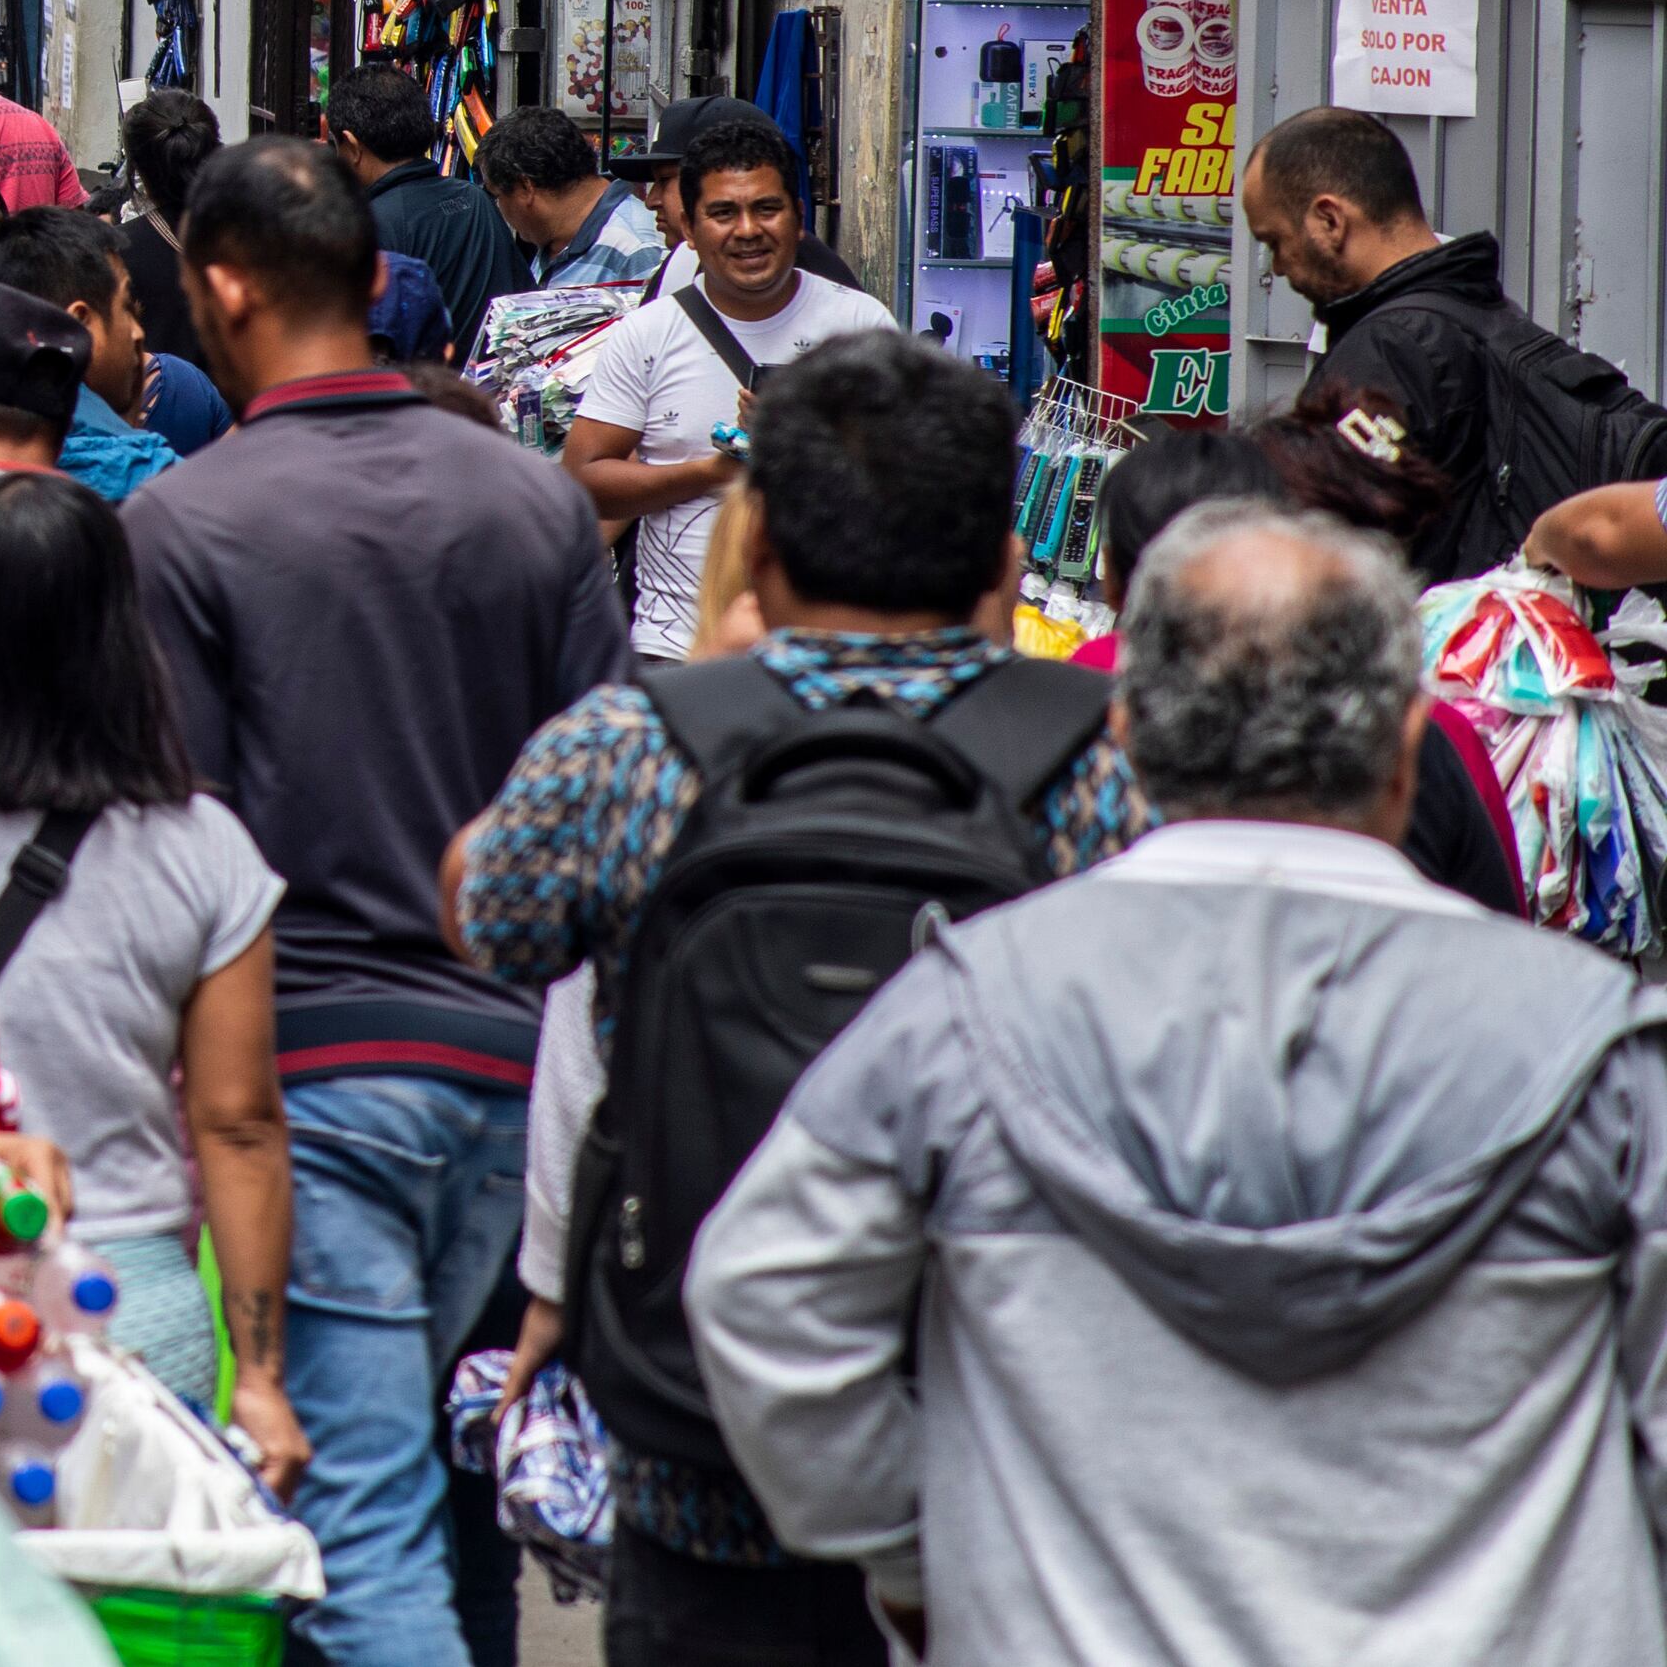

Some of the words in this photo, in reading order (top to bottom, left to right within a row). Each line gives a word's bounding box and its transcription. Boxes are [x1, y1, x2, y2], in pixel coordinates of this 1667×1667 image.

[1361, 29, 1397, 51] SOLO
[1403, 32, 1446, 53] POR
[1028, 61, 1038, 99] X-BASS
[1371, 66, 1431, 88] CAJON
[932, 177, 940, 202] SUPER
[931, 203, 939, 234] BASS
[1145, 284, 1228, 336] Cinta
